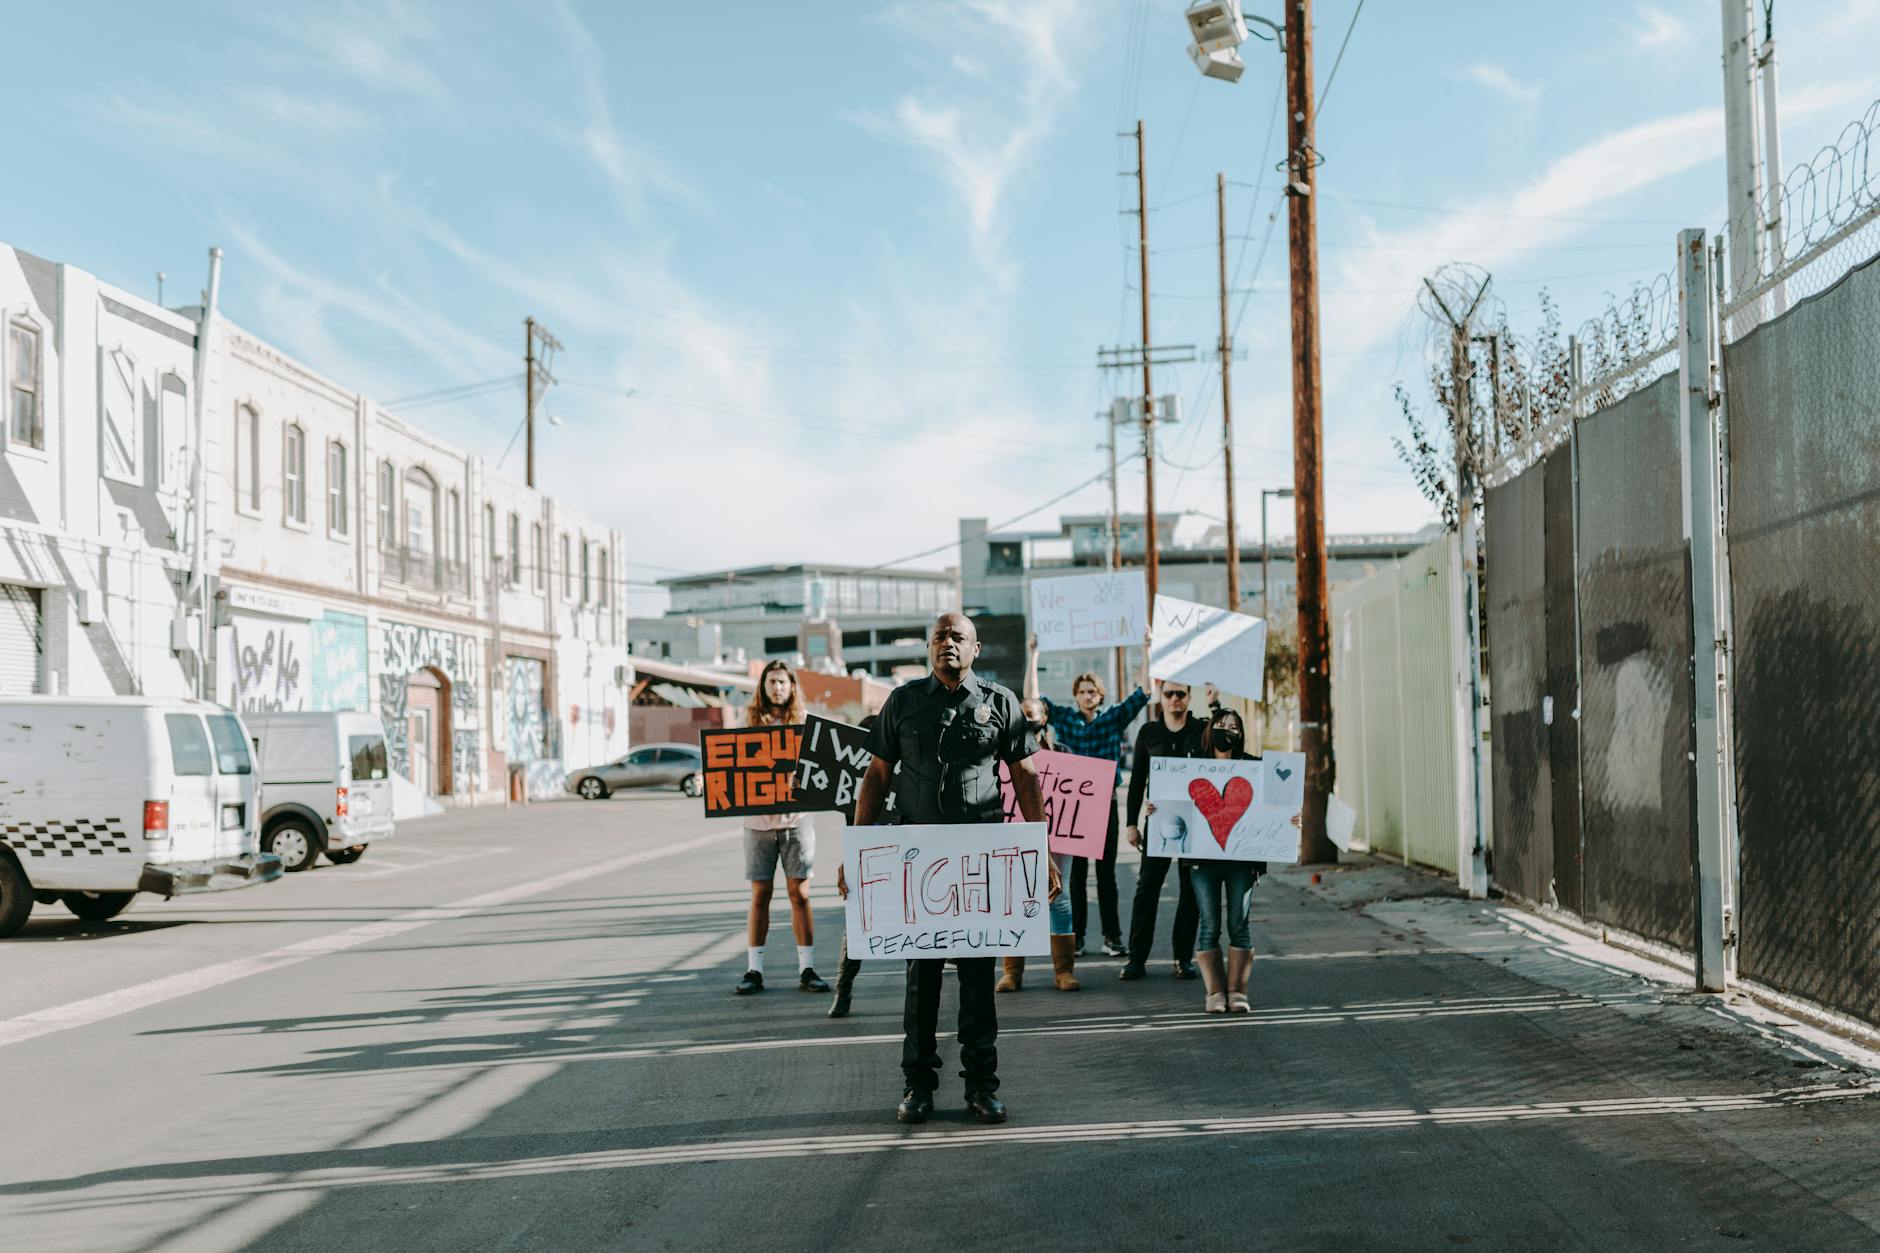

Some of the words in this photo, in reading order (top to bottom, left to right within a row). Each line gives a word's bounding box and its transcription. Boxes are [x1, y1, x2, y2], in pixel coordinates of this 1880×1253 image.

[705, 729, 803, 769] EQU
[810, 721, 822, 752] I
[706, 769, 799, 811] RIGH
[869, 929, 1026, 955] PEACEFULLY
